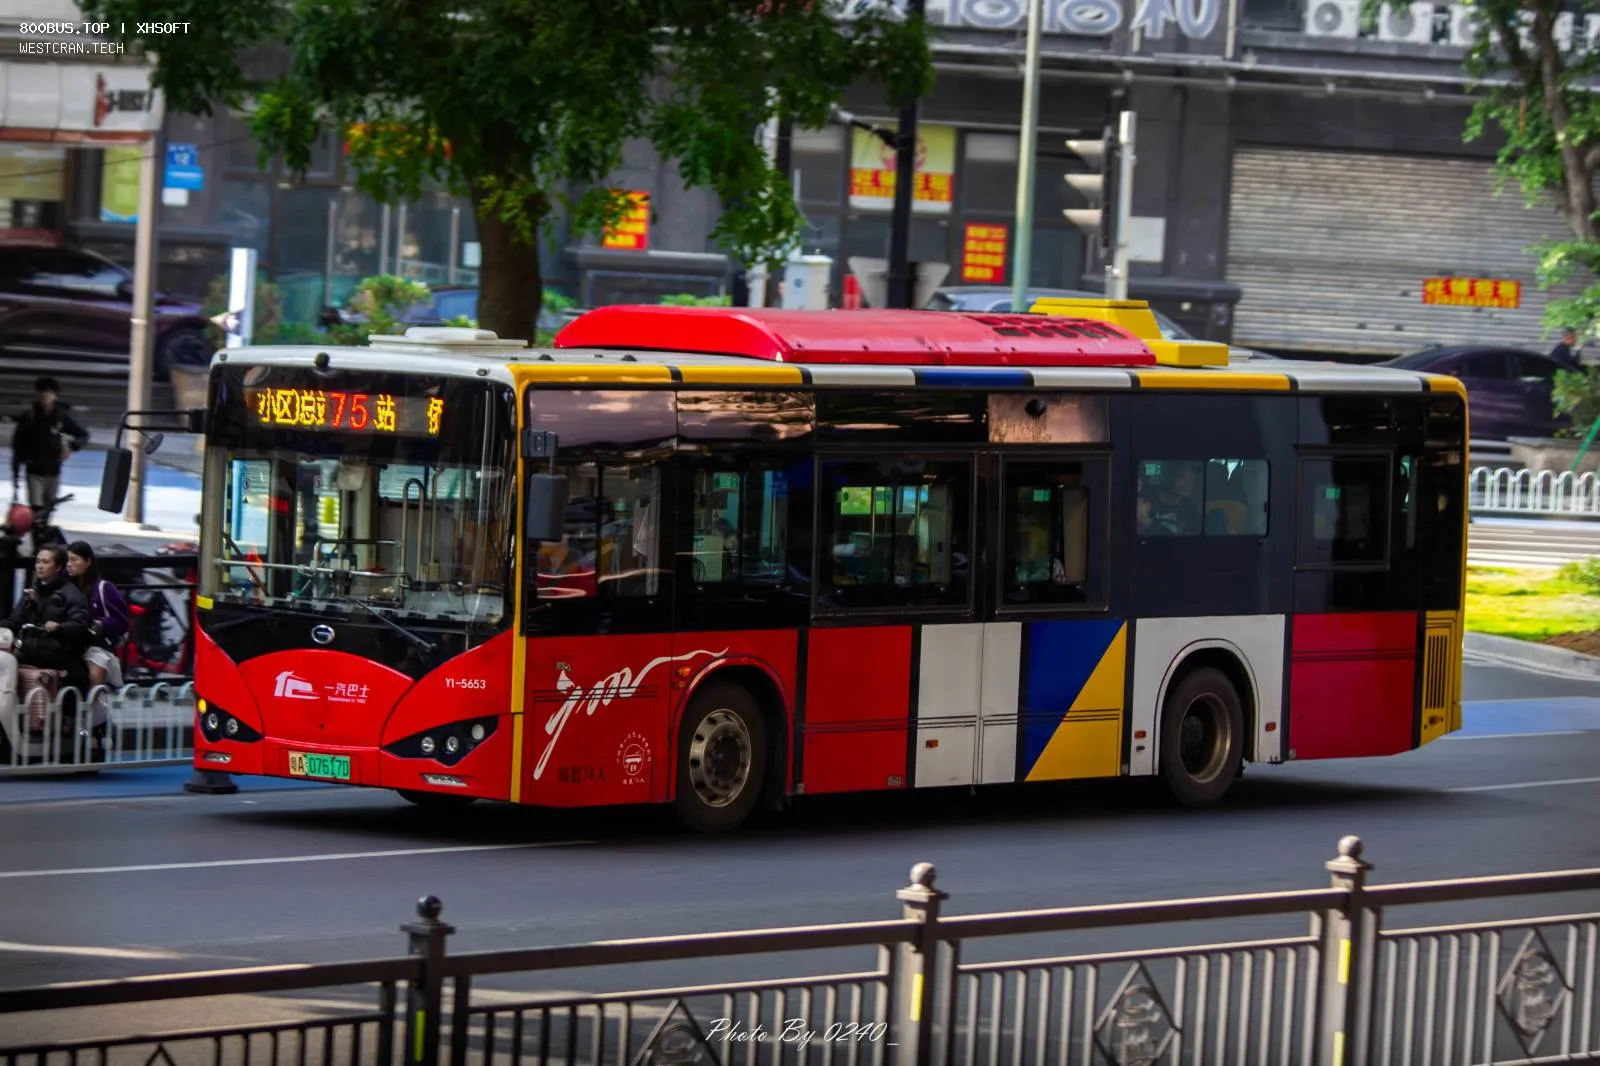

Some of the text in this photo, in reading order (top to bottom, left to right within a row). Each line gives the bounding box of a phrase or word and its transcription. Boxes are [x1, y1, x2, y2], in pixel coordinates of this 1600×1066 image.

[328, 391, 369, 429] 75
[324, 682, 370, 697] 一汽巴士
[445, 677, 486, 689] Y1-5653
